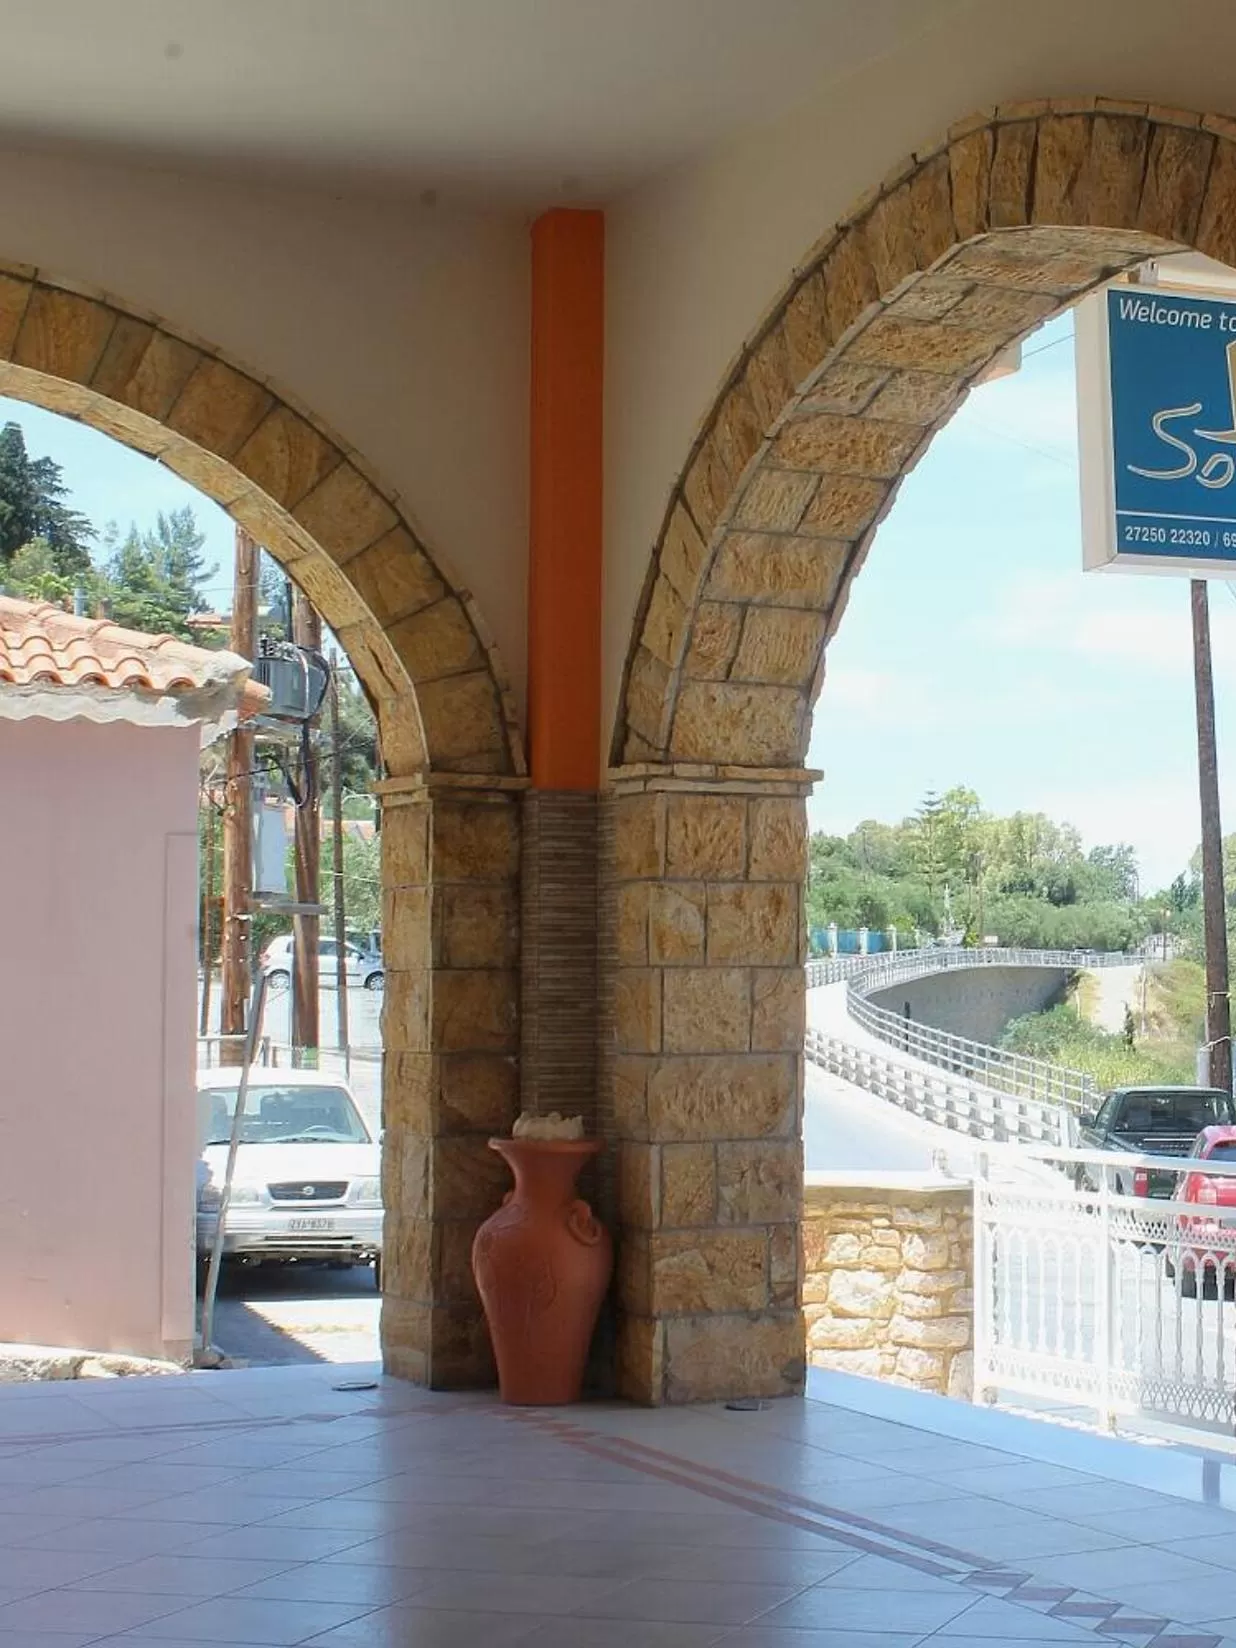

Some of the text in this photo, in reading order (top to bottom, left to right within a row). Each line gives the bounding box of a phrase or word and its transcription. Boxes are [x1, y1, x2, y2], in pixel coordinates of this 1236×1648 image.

[1119, 297, 1212, 329] Welcome
[1125, 525, 1166, 542] 27250
[1170, 528, 1211, 546] 22320
